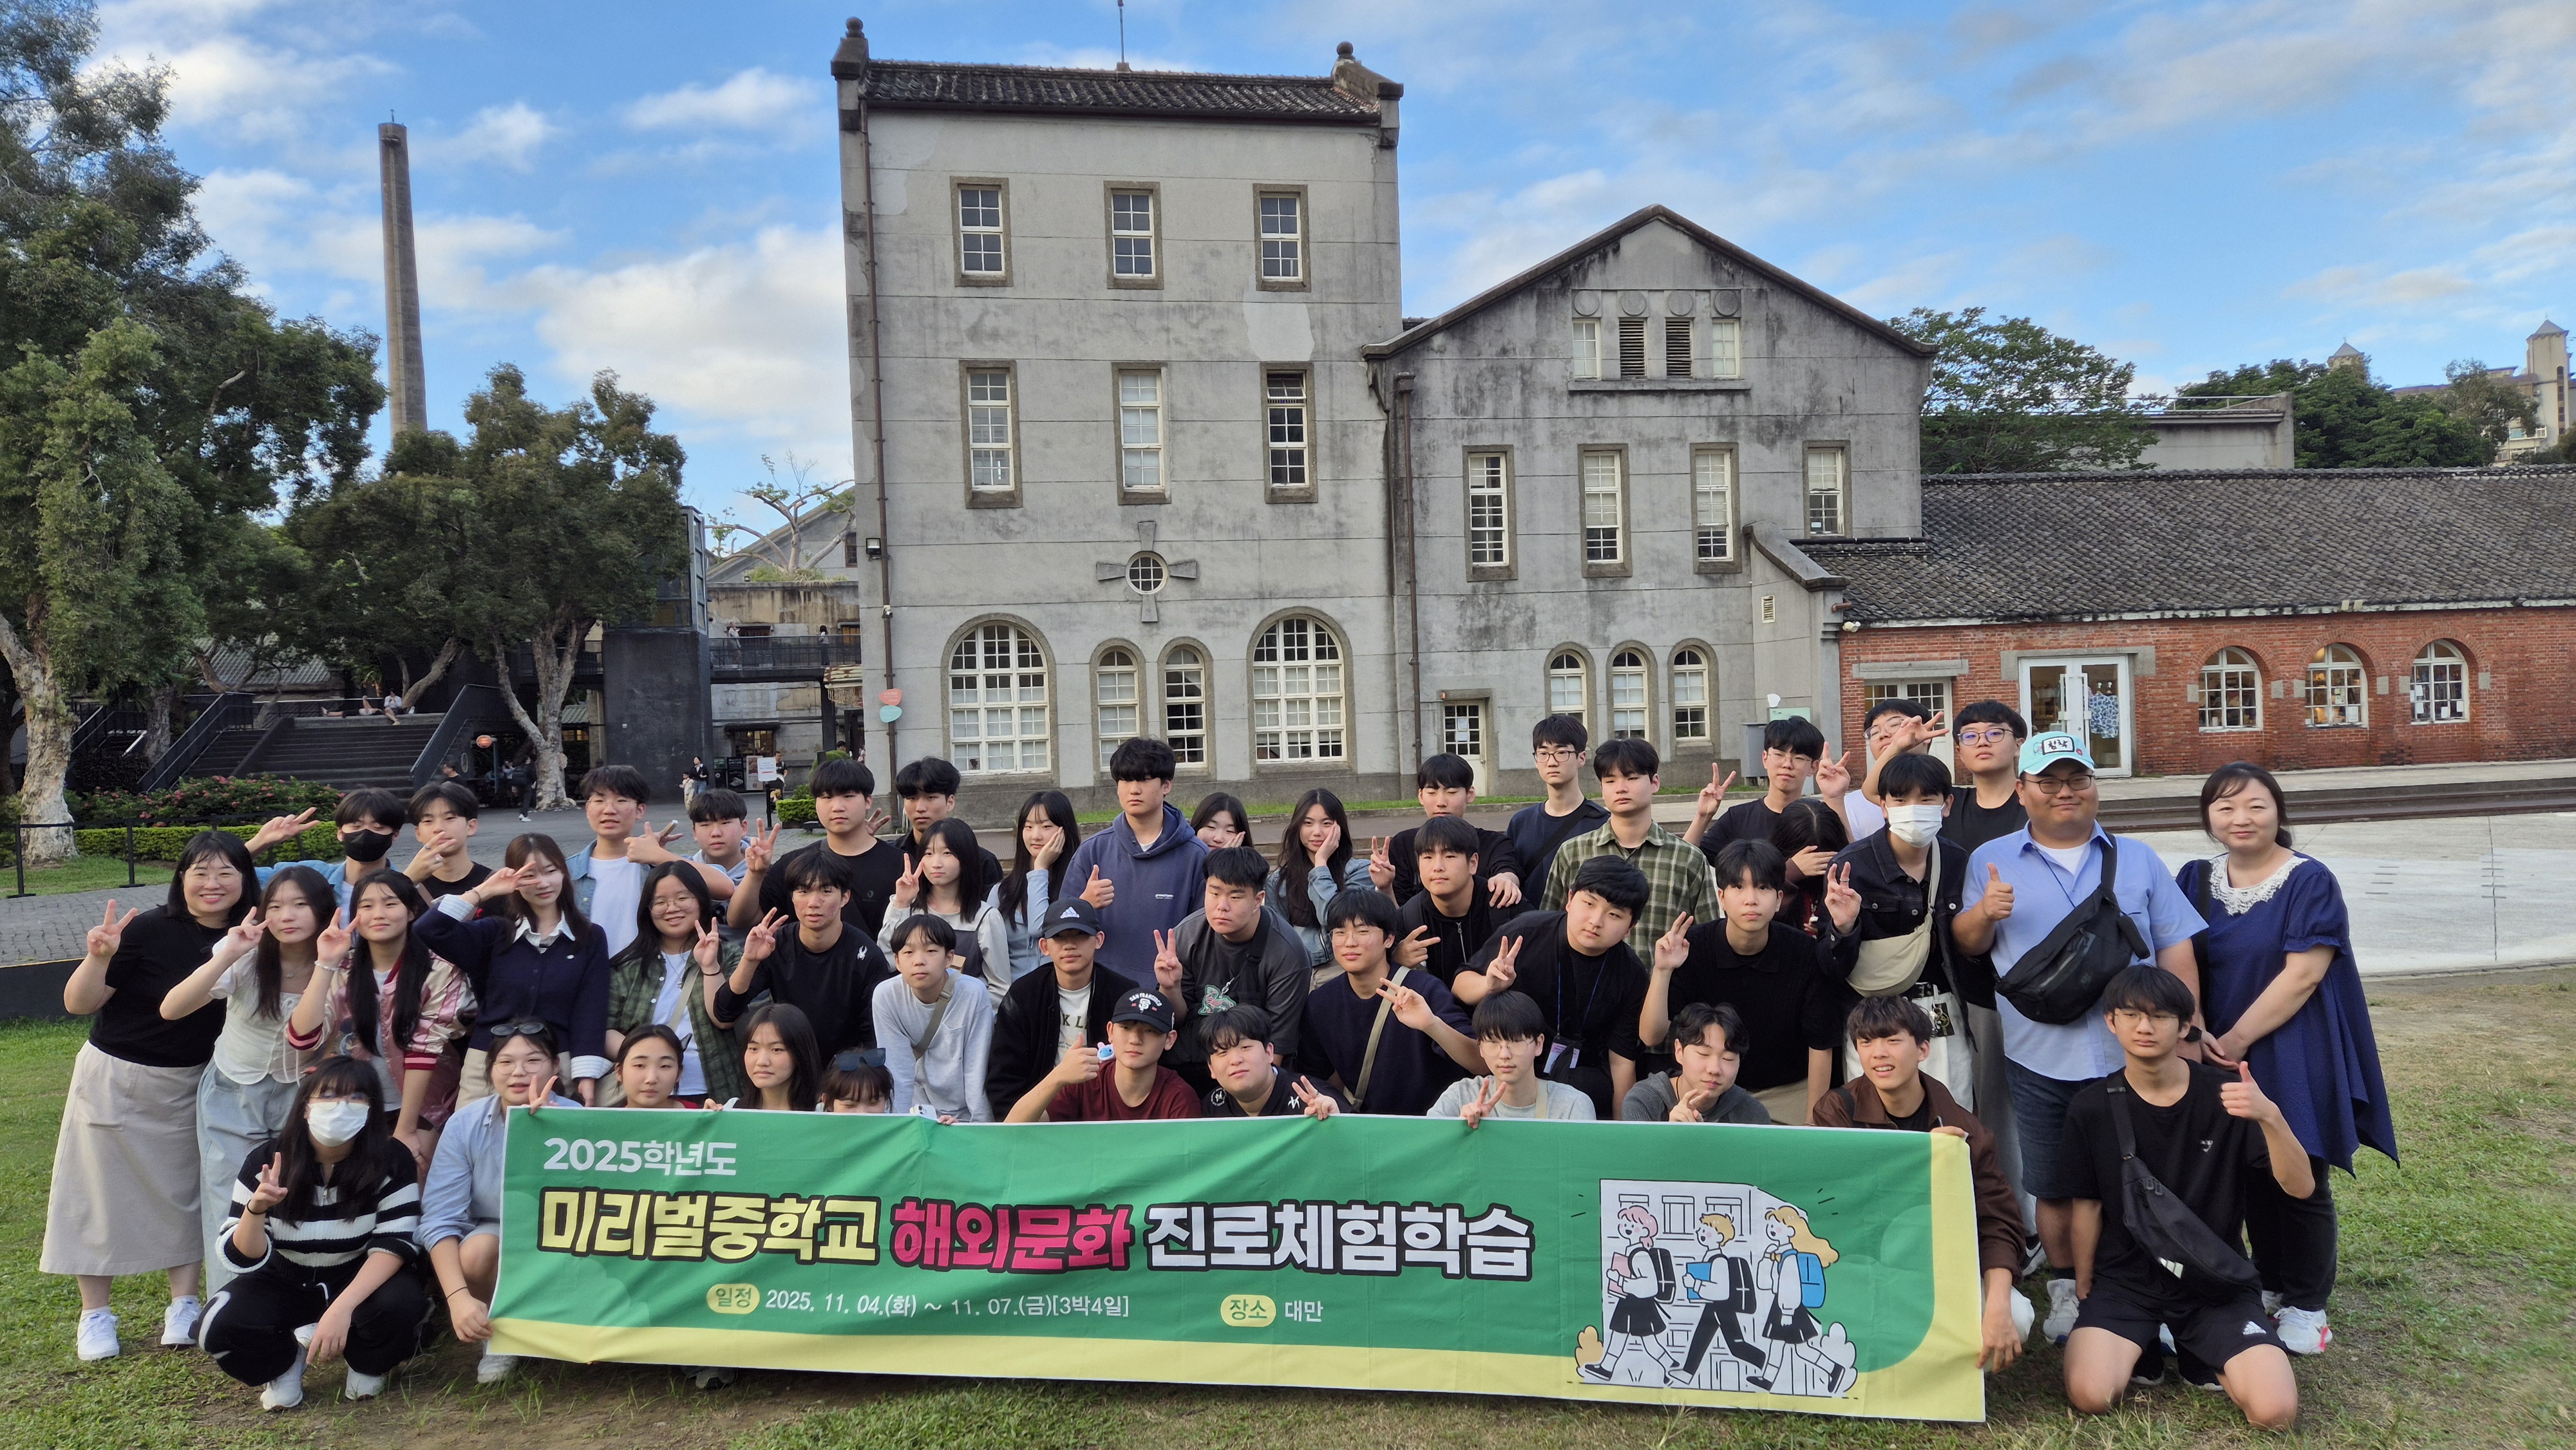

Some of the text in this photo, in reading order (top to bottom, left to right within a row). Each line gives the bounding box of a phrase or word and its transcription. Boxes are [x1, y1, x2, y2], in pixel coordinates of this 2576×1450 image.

[544, 1138, 737, 1176] 2025학년도
[540, 1189, 1531, 1278] 미리벌중학교 해외문화 진로체험학습
[715, 1287, 752, 1308] 일정
[765, 1289, 815, 1312] 2025.
[825, 1293, 849, 1314] 11.
[857, 1294, 917, 1317] 04.(화)
[951, 1299, 980, 1316] 11.
[1229, 1299, 1268, 1321] 장소
[1285, 1300, 1324, 1323] 대만
